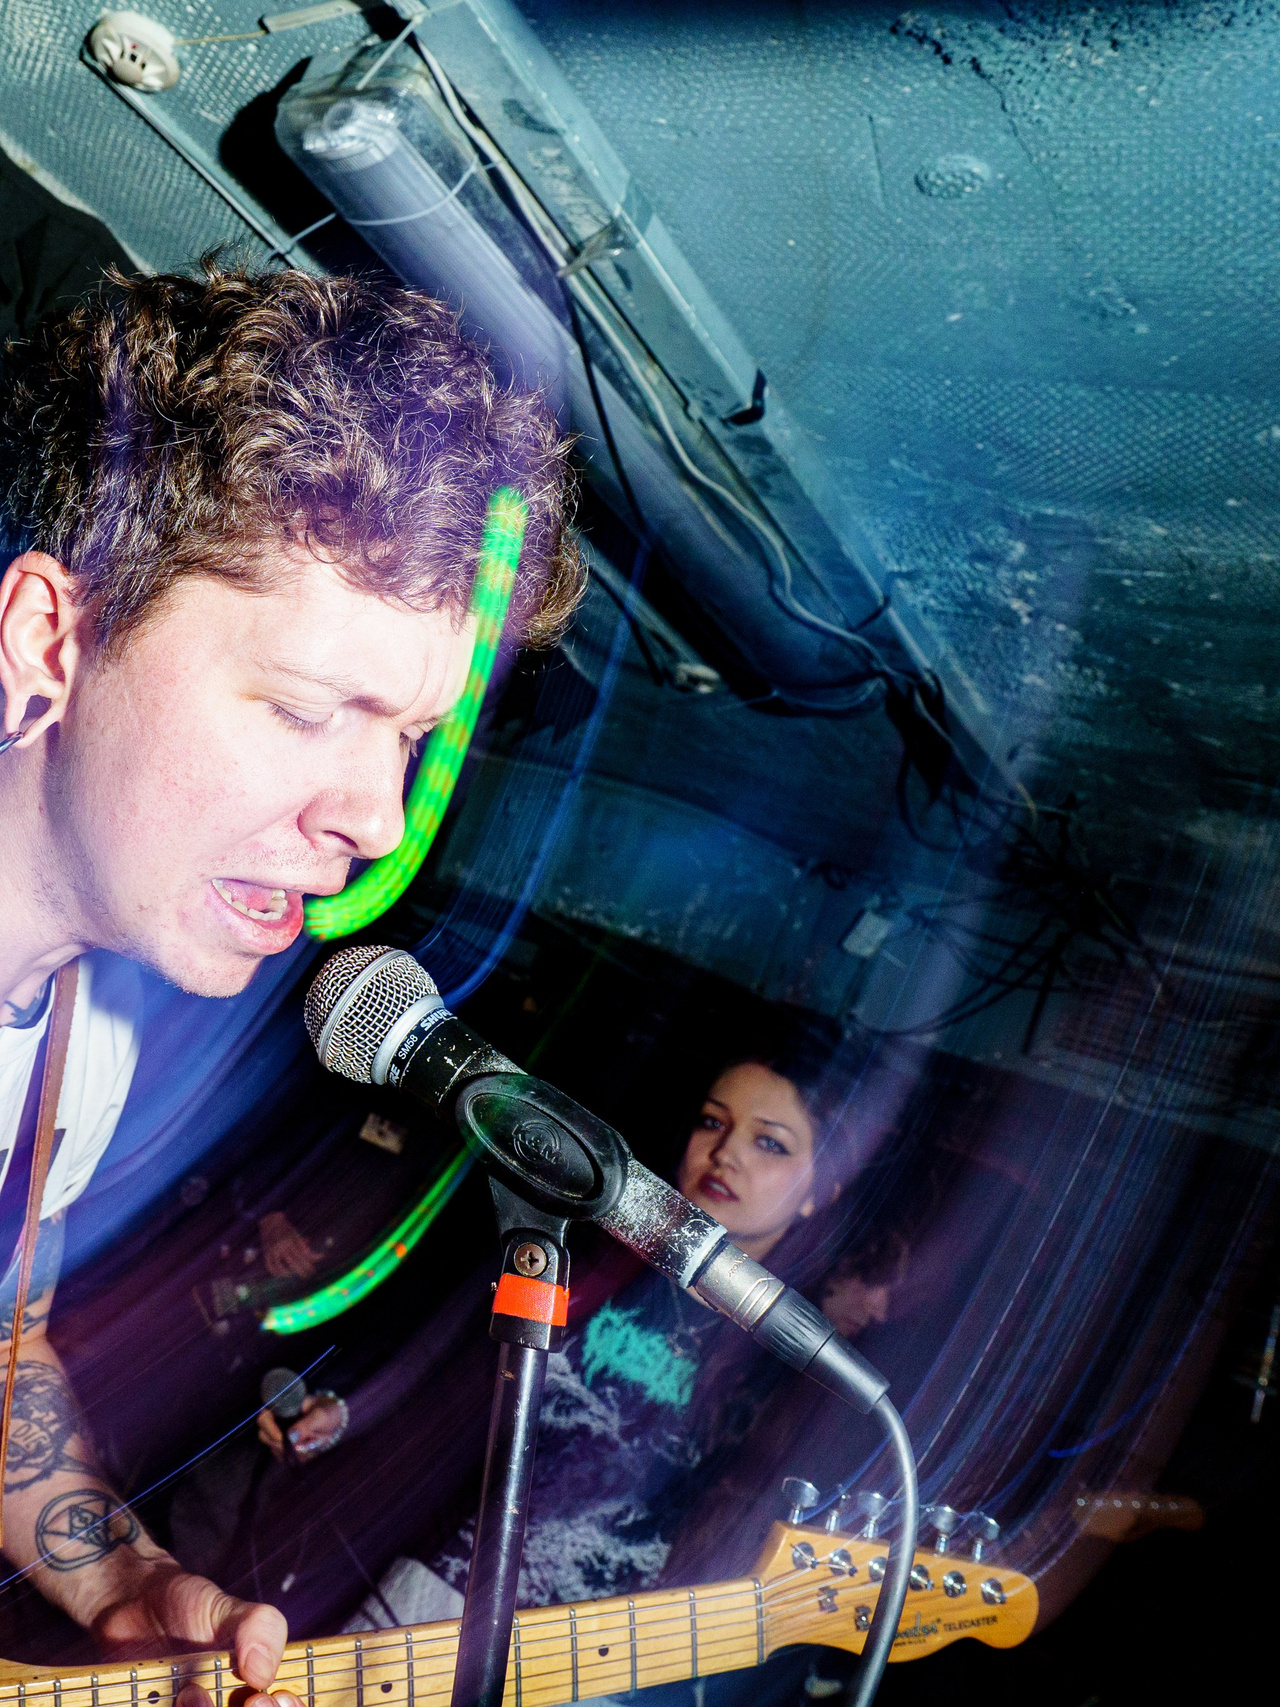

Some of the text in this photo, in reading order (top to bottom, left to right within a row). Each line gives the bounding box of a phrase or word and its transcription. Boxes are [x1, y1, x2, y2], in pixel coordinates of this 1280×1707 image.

[397, 1008, 454, 1060] SM58 SHUR
[943, 1615, 998, 1633] TELECASTER
